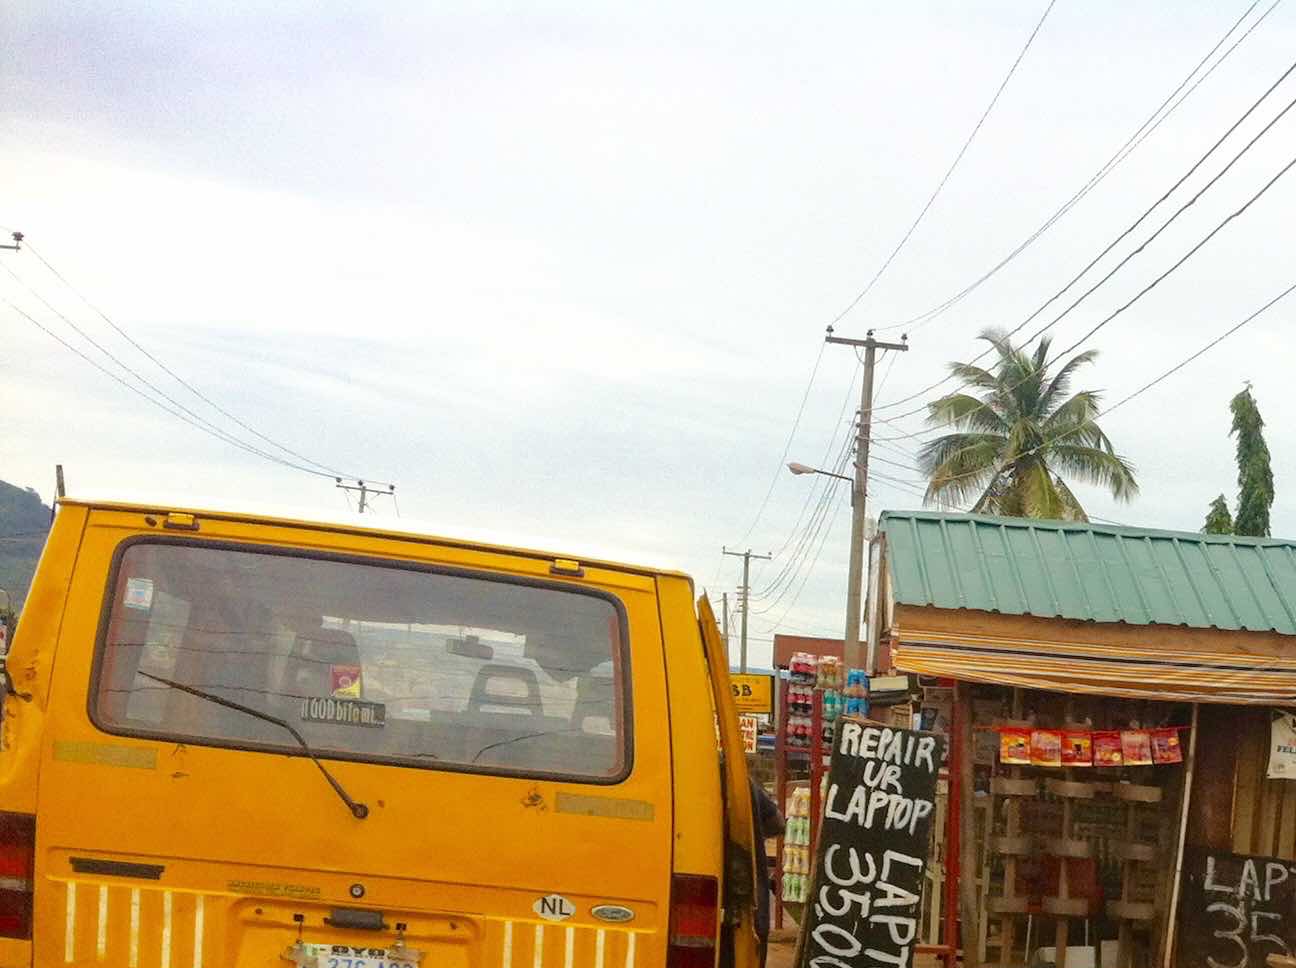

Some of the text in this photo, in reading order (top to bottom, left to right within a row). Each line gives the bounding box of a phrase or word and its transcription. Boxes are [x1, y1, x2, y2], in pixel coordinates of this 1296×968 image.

[840, 723, 935, 773] REPAIR
[863, 761, 902, 794] UR
[825, 784, 933, 836] LAPTOP
[541, 897, 570, 916] NL
